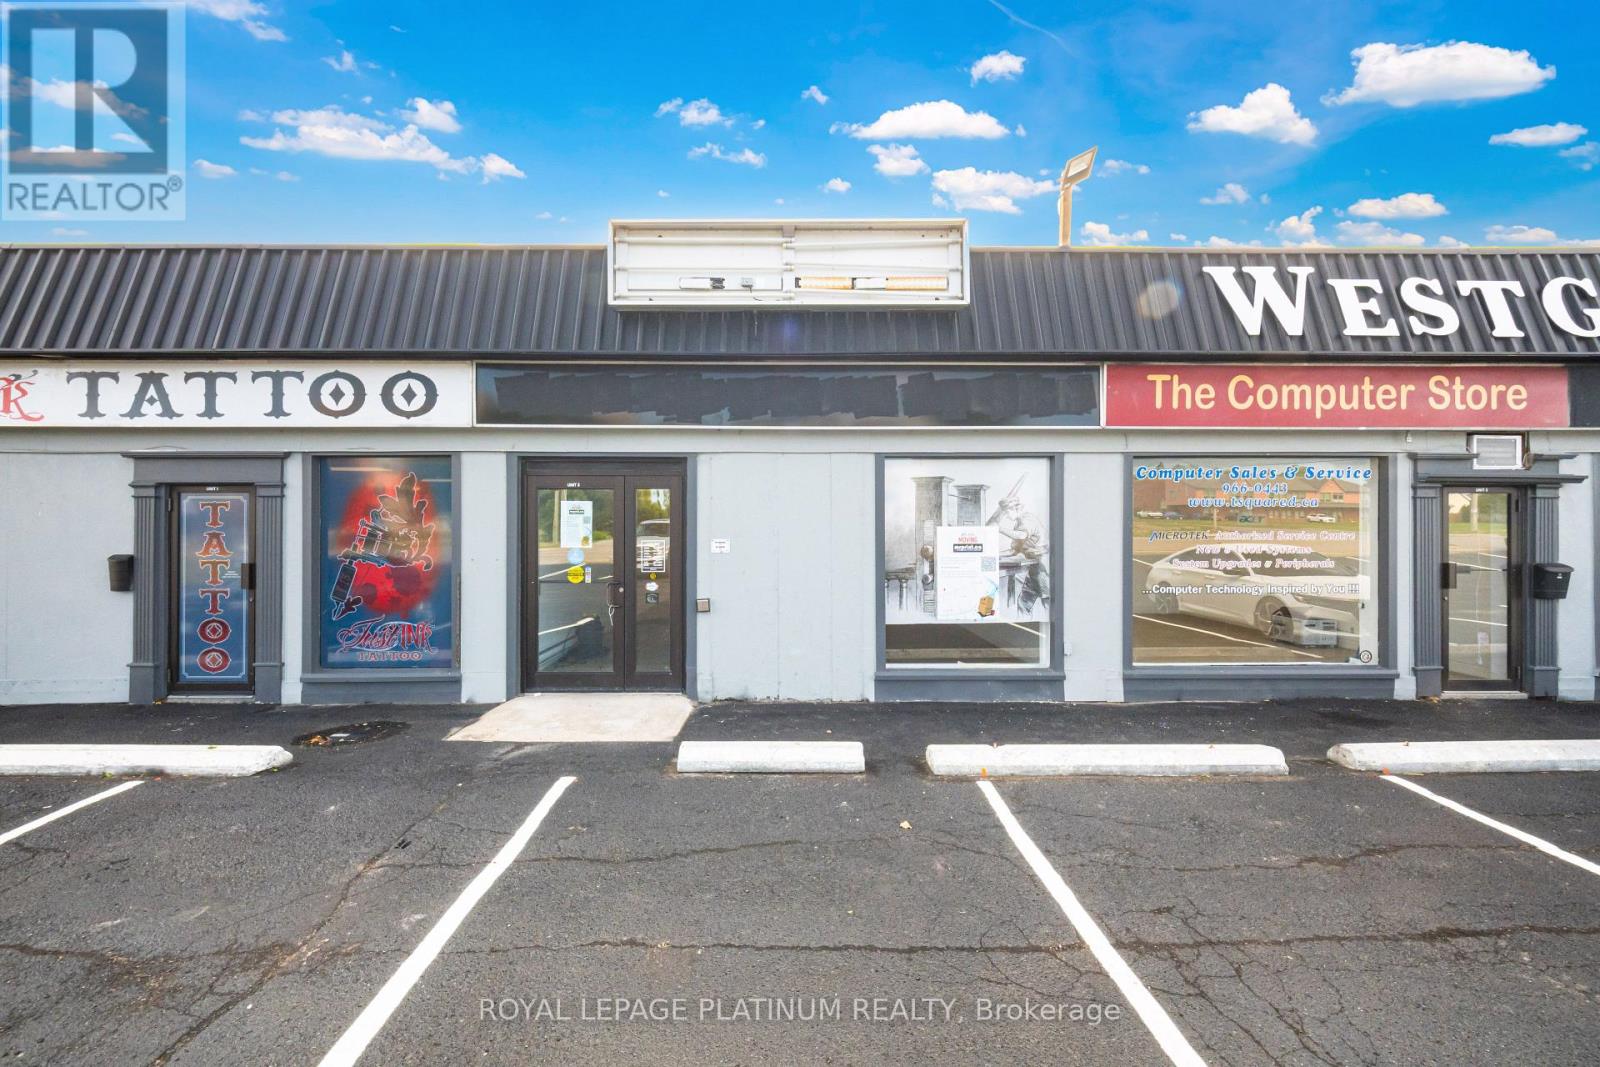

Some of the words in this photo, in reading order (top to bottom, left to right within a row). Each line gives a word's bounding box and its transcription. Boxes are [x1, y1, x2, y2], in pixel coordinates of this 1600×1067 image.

[66, 369, 440, 420] TATTOO
[1147, 374, 1216, 410] The
[1228, 375, 1416, 419] Computer
[1428, 375, 1528, 410] Store
[1135, 466, 1223, 483] Computer
[1229, 466, 1277, 480] Sales
[1284, 466, 1298, 480] &
[1305, 466, 1372, 480] Service
[1222, 482, 1289, 494] 966-0443
[1148, 530, 1209, 544] MICROTEK
[195, 501, 234, 674] TATTOO
[1206, 584, 1264, 595] Technology
[1268, 584, 1309, 595] Inspired
[1311, 584, 1323, 594] by
[1327, 584, 1346, 594] You
[358, 650, 423, 661] TATTOO
